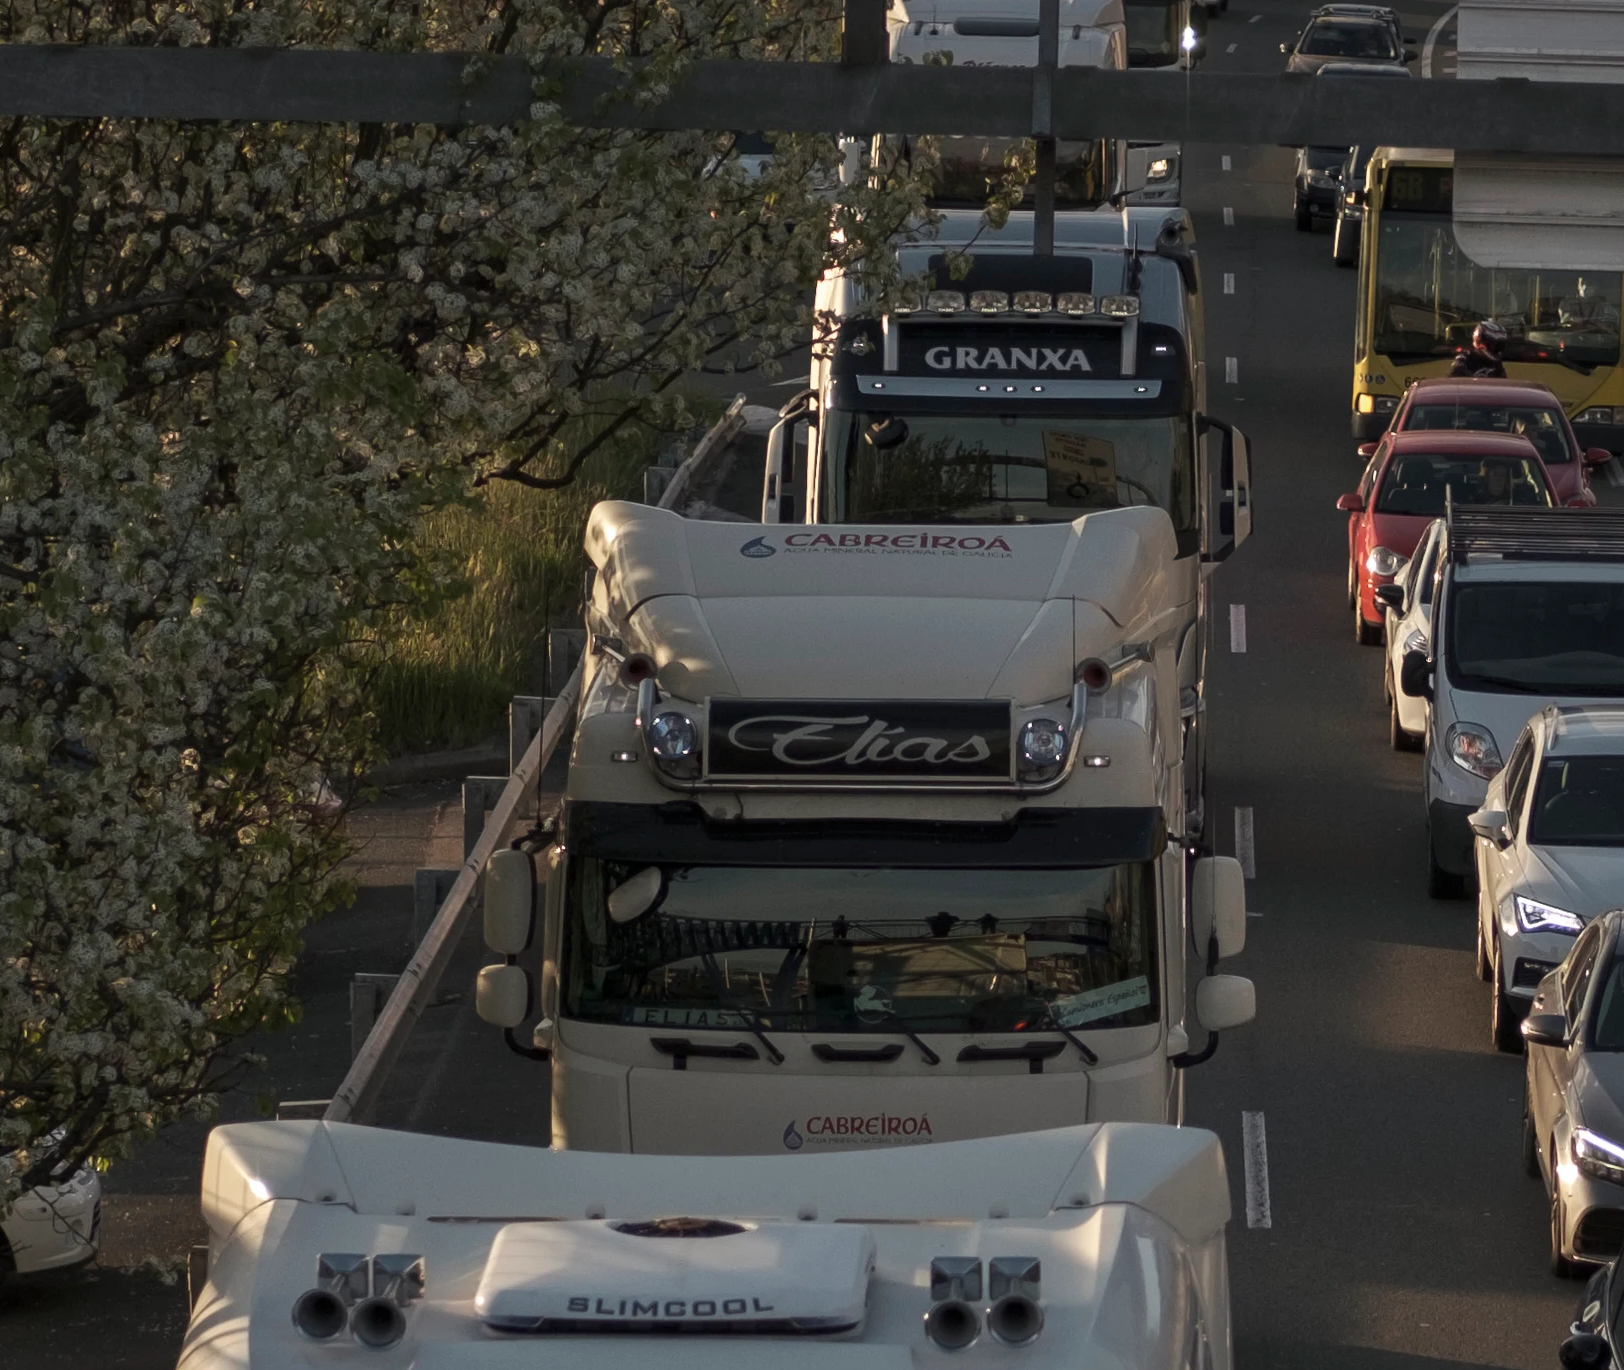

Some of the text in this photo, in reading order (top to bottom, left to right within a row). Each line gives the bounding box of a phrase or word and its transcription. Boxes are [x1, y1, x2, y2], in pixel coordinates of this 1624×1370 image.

[924, 346, 1093, 372] GRANXA
[644, 1008, 727, 1026] ELIAS
[567, 1297, 775, 1317] SLIMCOOL
